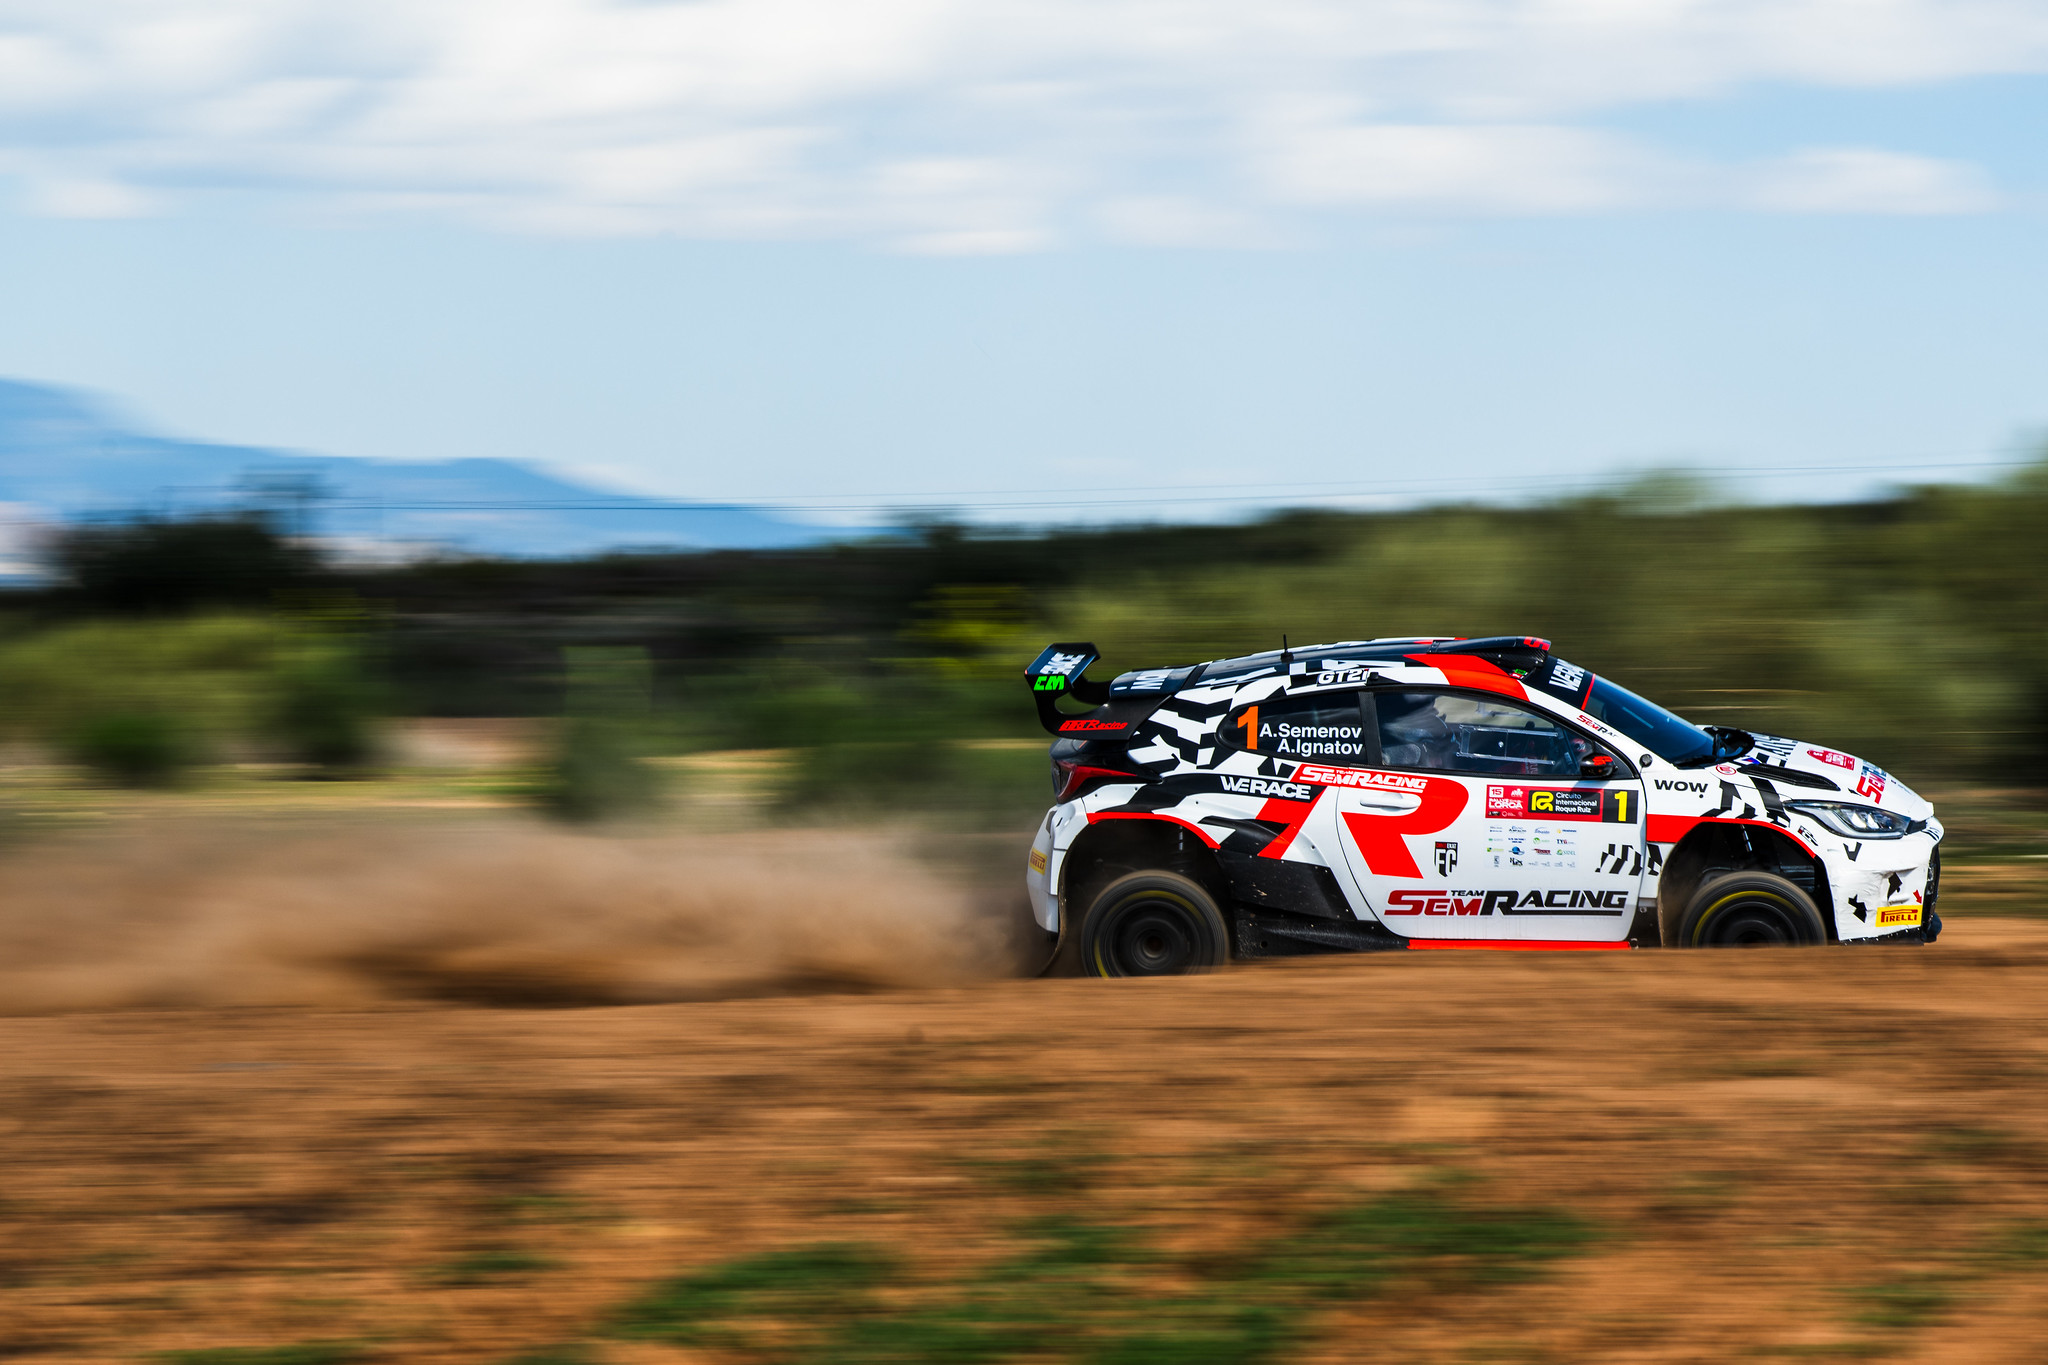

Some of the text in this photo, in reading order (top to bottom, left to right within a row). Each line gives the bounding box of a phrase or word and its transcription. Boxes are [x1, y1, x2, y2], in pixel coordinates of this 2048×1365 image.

[1318, 668, 1370, 685] GT2i
[1237, 706, 1259, 750] 1
[1259, 723, 1362, 739] A.Semenov
[1277, 738, 1364, 757] A.Ignatov
[1220, 775, 1312, 800] WERACE
[1654, 779, 1709, 793] WOW
[1555, 798, 1597, 807] Internacional
[1555, 805, 1577, 813] Roque
[1614, 791, 1628, 822] 1
[1881, 908, 1919, 923] PIRELLI
